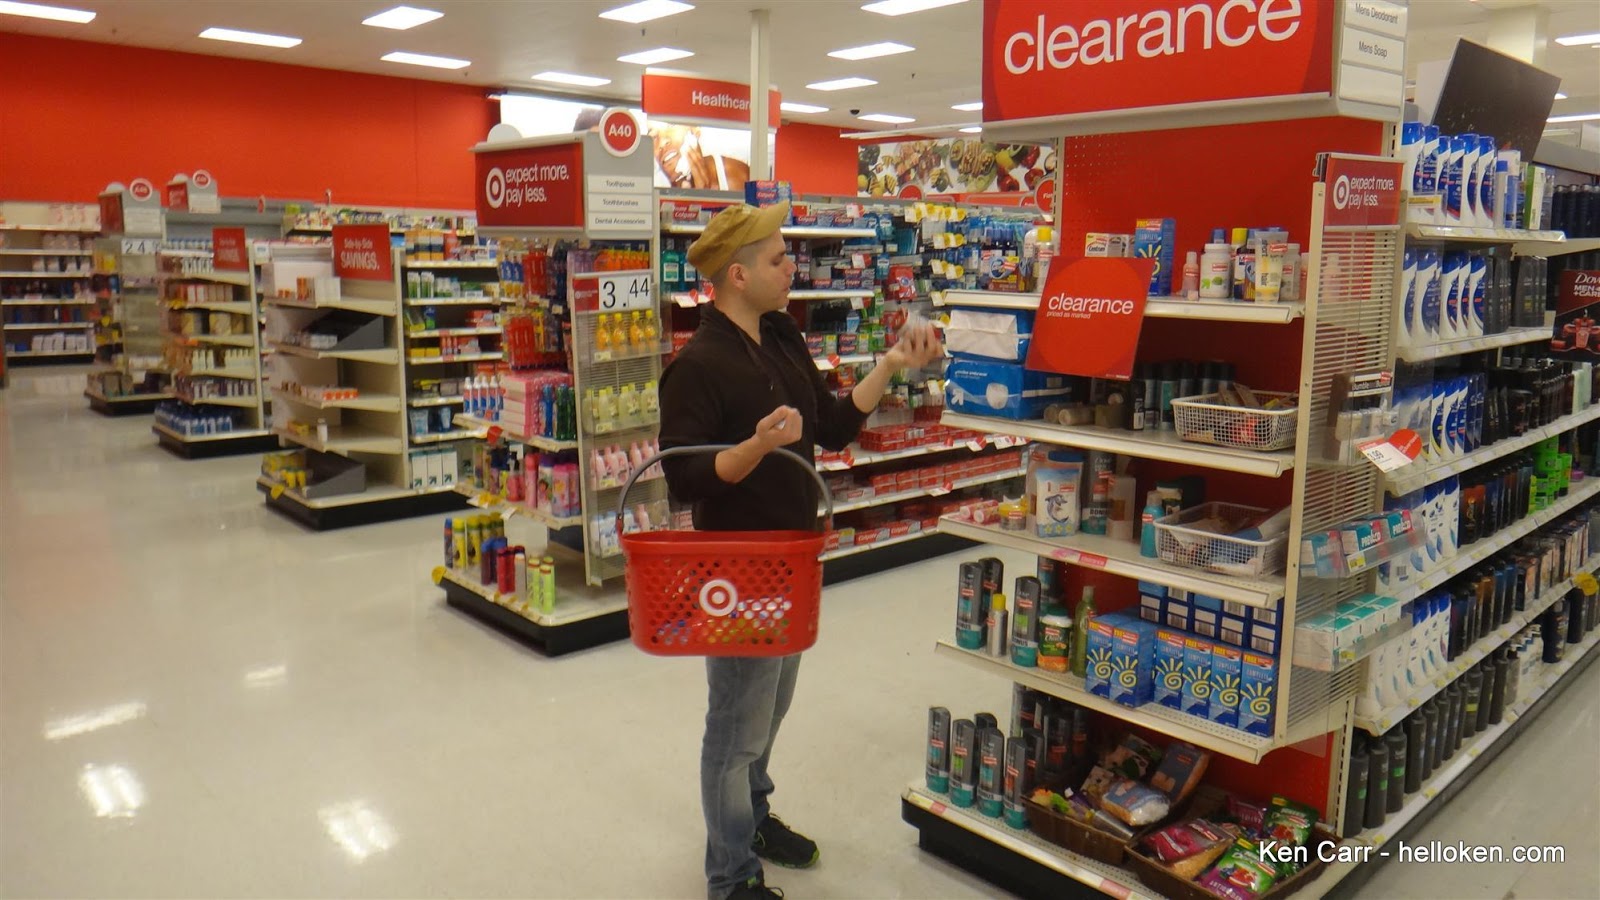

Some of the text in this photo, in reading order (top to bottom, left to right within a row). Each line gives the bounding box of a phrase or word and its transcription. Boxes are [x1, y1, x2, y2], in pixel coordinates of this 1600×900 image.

[1355, 2, 1399, 24] Mens Deodorant
[1004, 0, 1302, 75] clearance
[1359, 41, 1388, 59] Mens Soap
[691, 90, 751, 111] Healthcar
[608, 123, 632, 138] A40
[505, 163, 569, 187] expect more.
[606, 180, 635, 189] Toothpaste
[1350, 175, 1395, 193] expect more.
[505, 184, 548, 208] pay less.
[602, 198, 639, 207] Toothbrushes
[1348, 194, 1363, 209] pay
[595, 217, 646, 225] Dental Accessories
[674, 211, 697, 219] Colgate
[798, 216, 816, 224] Colgate
[340, 251, 380, 271] SAVINGS.
[1575, 272, 1600, 284] Dov
[1048, 292, 1134, 315] clearance
[1046, 310, 1063, 319] priced
[1070, 312, 1092, 320] marked
[858, 532, 877, 541] Colgate
